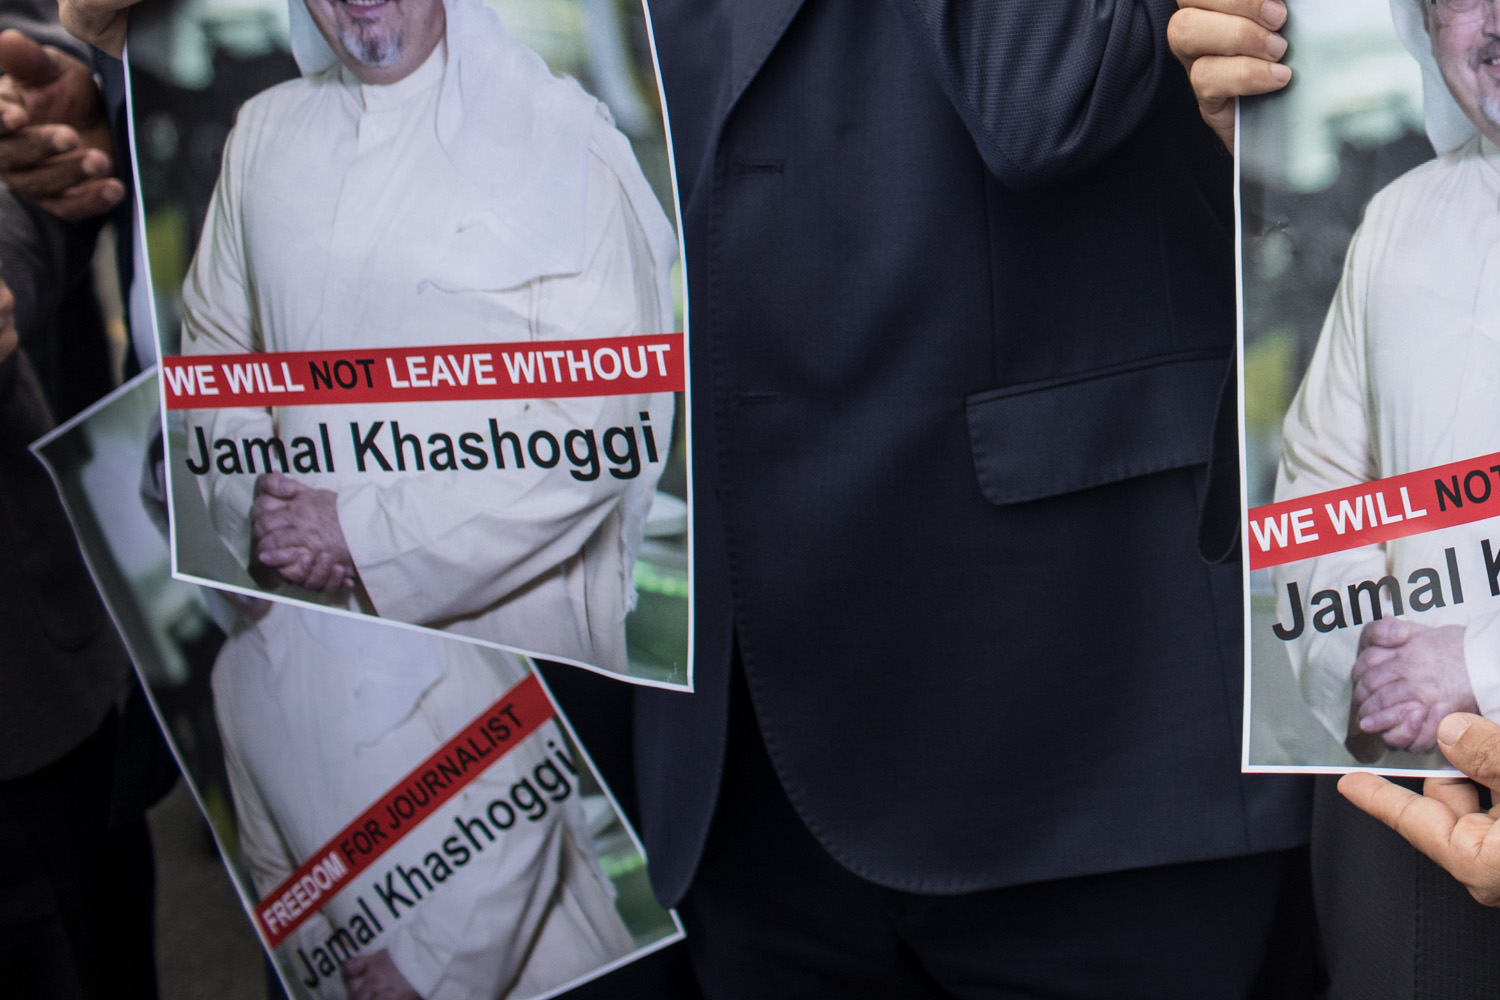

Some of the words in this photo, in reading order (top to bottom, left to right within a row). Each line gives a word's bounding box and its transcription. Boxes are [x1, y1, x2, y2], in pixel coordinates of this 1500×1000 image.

[165, 364, 219, 397] WE
[223, 360, 305, 395] WILL
[310, 358, 376, 390] NOT
[386, 351, 498, 389] LEAVE
[501, 343, 672, 384] WITHOUT
[185, 422, 335, 476] Jamal
[350, 411, 660, 482] Khashoggi
[1249, 507, 1317, 552] WE
[1325, 486, 1427, 536] WILL
[1272, 547, 1465, 642] Jamal
[261, 852, 346, 935] FREEDOM
[341, 818, 388, 865] FOR
[388, 704, 523, 832] JOURNALIST
[296, 897, 385, 990] Jamal
[371, 739, 579, 922] Khashoggi
